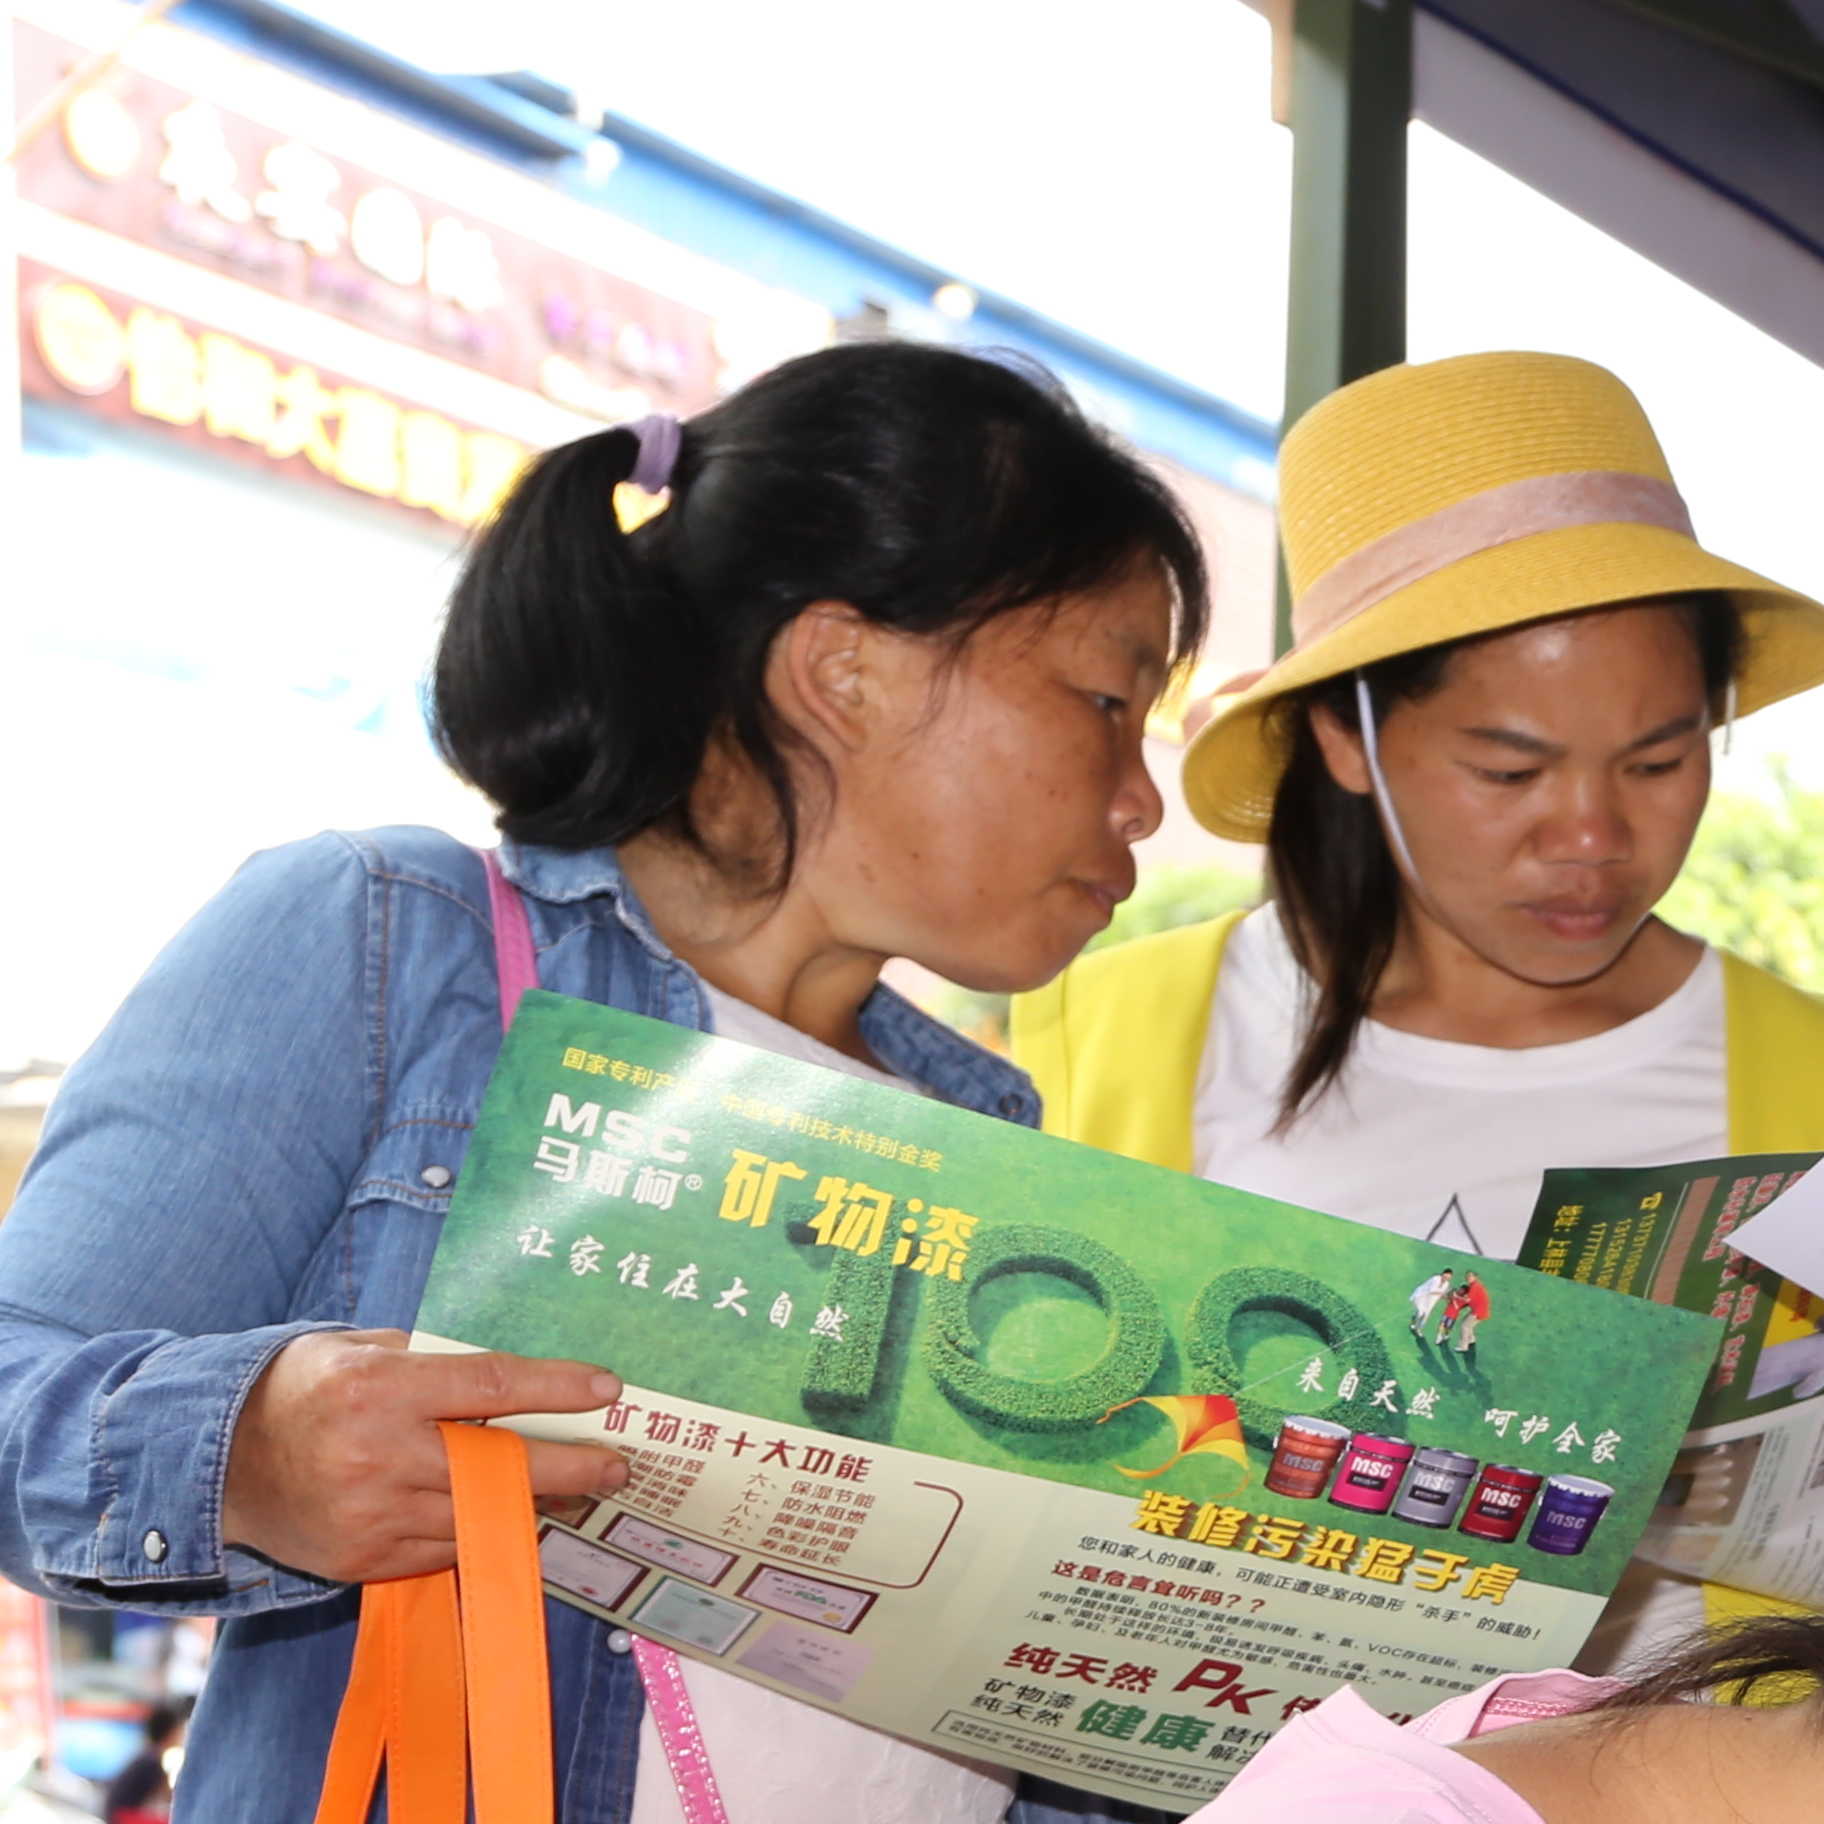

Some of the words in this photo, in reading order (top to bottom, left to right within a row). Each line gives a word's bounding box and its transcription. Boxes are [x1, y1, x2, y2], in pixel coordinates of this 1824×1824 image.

[543, 1093, 693, 1164] MSC
[717, 1147, 981, 1282] 矿物漆
[603, 1402, 873, 1483] 矿物漆十大功能
[1297, 1357, 1441, 1421] 来自天然
[1483, 1407, 1622, 1464] 呵护全家
[782, 1495, 868, 1524] 防水阻燃
[1128, 1489, 1522, 1606] 装修污染猛子虎
[971, 1694, 1065, 1728] 纯天然
[982, 1678, 1074, 1710] 矿物漆
[1003, 1643, 1157, 1694] 纯天然
[1173, 1658, 1282, 1716] PK
[1076, 1700, 1217, 1753] 健康
